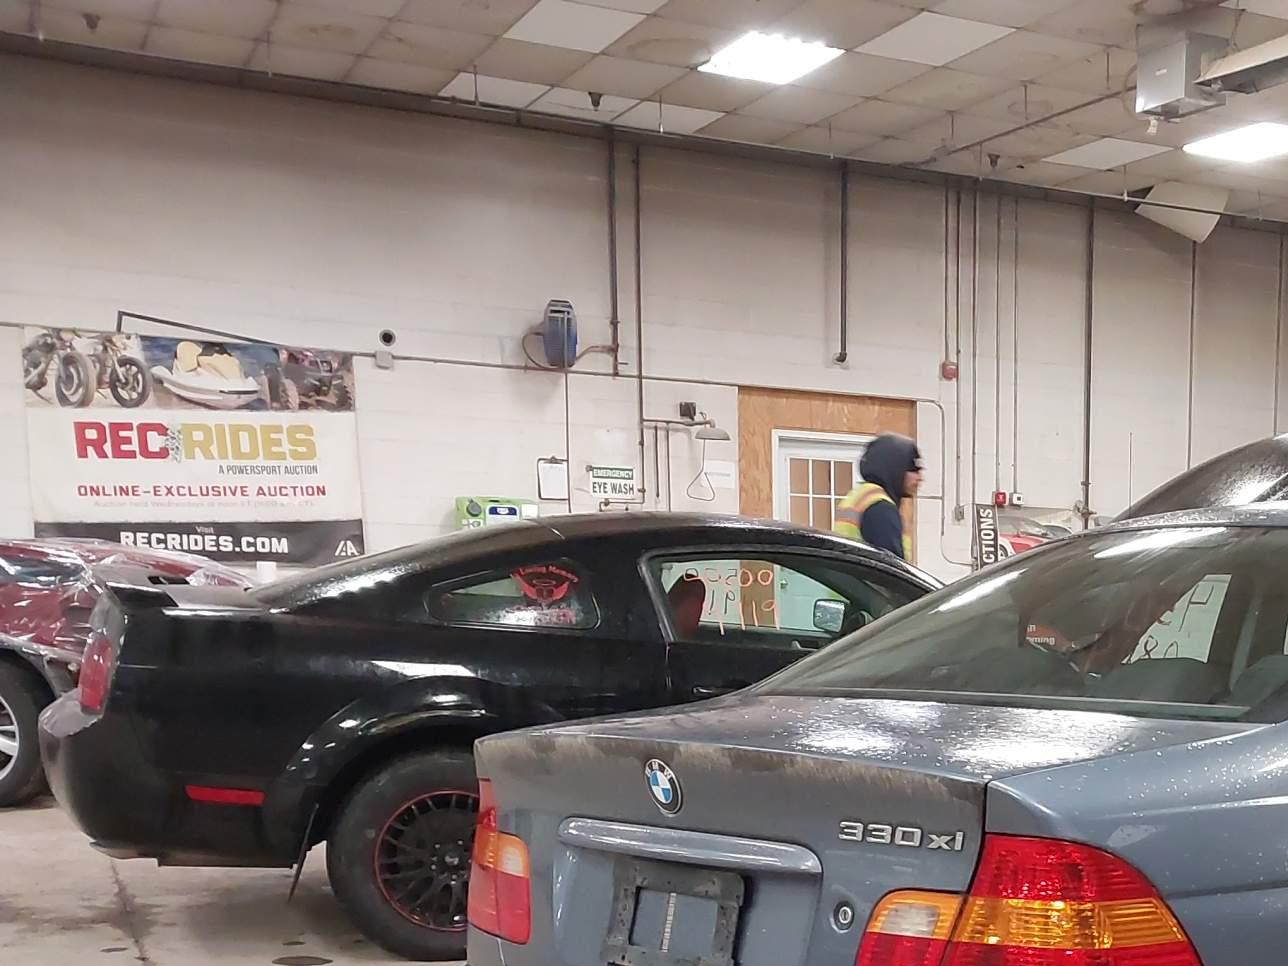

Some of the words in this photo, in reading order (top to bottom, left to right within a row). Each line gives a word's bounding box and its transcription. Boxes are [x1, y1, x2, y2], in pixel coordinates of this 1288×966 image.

[73, 421, 170, 459] REC
[183, 423, 317, 461] RIDES
[218, 464, 224, 475] A
[226, 464, 282, 475] POWERSPORT
[284, 465, 318, 475] AUCTION
[593, 469, 633, 479] EMERGENCY
[77, 485, 249, 497] ONLINE-EXCLUSIVE
[256, 485, 327, 497] AUCTION
[592, 482, 608, 494] EYE
[610, 482, 634, 495] WASH
[120, 531, 288, 553] RECRIDES.COM
